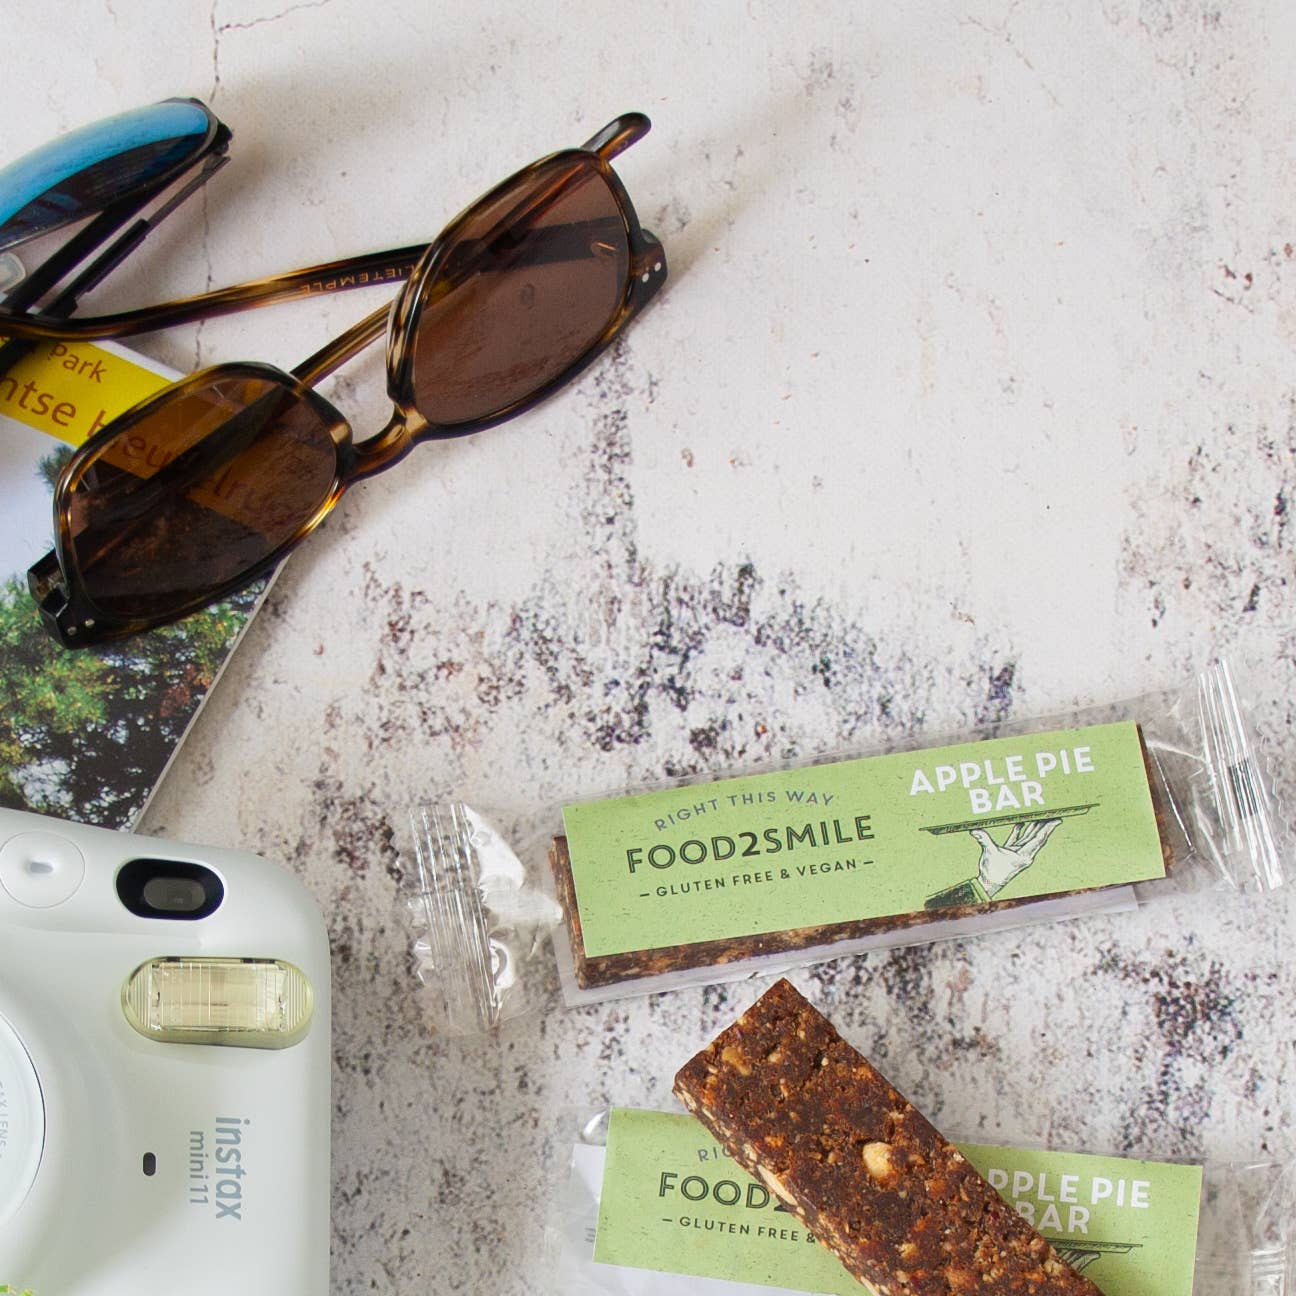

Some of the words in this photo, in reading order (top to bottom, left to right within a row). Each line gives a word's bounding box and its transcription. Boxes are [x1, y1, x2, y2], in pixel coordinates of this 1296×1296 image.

[300, 264, 416, 295] LIETEMPLE
[909, 755, 1027, 796] APPLE
[1035, 746, 1095, 778] PIE
[654, 798, 719, 832] RIGHT
[727, 791, 777, 807] THIS
[786, 790, 835, 807] WAY
[969, 781, 1045, 814] BAR
[626, 815, 875, 874] FOOD2SMILE
[656, 877, 726, 897] GLUTEN
[732, 870, 774, 887] FREE
[780, 868, 791, 880] &
[796, 858, 857, 876] VEGAN
[189, 1130, 209, 1179] mini
[215, 1116, 250, 1221] instax
[189, 1184, 209, 1204] 11
[659, 1171, 790, 1212] FOOD
[988, 1168, 1080, 1203] PPLE
[1091, 1176, 1151, 1209] PIE
[679, 1216, 750, 1236] GLUTEN
[757, 1226, 799, 1241] FREE
[806, 1232, 816, 1244] &
[1015, 1200, 1091, 1234] BAR
